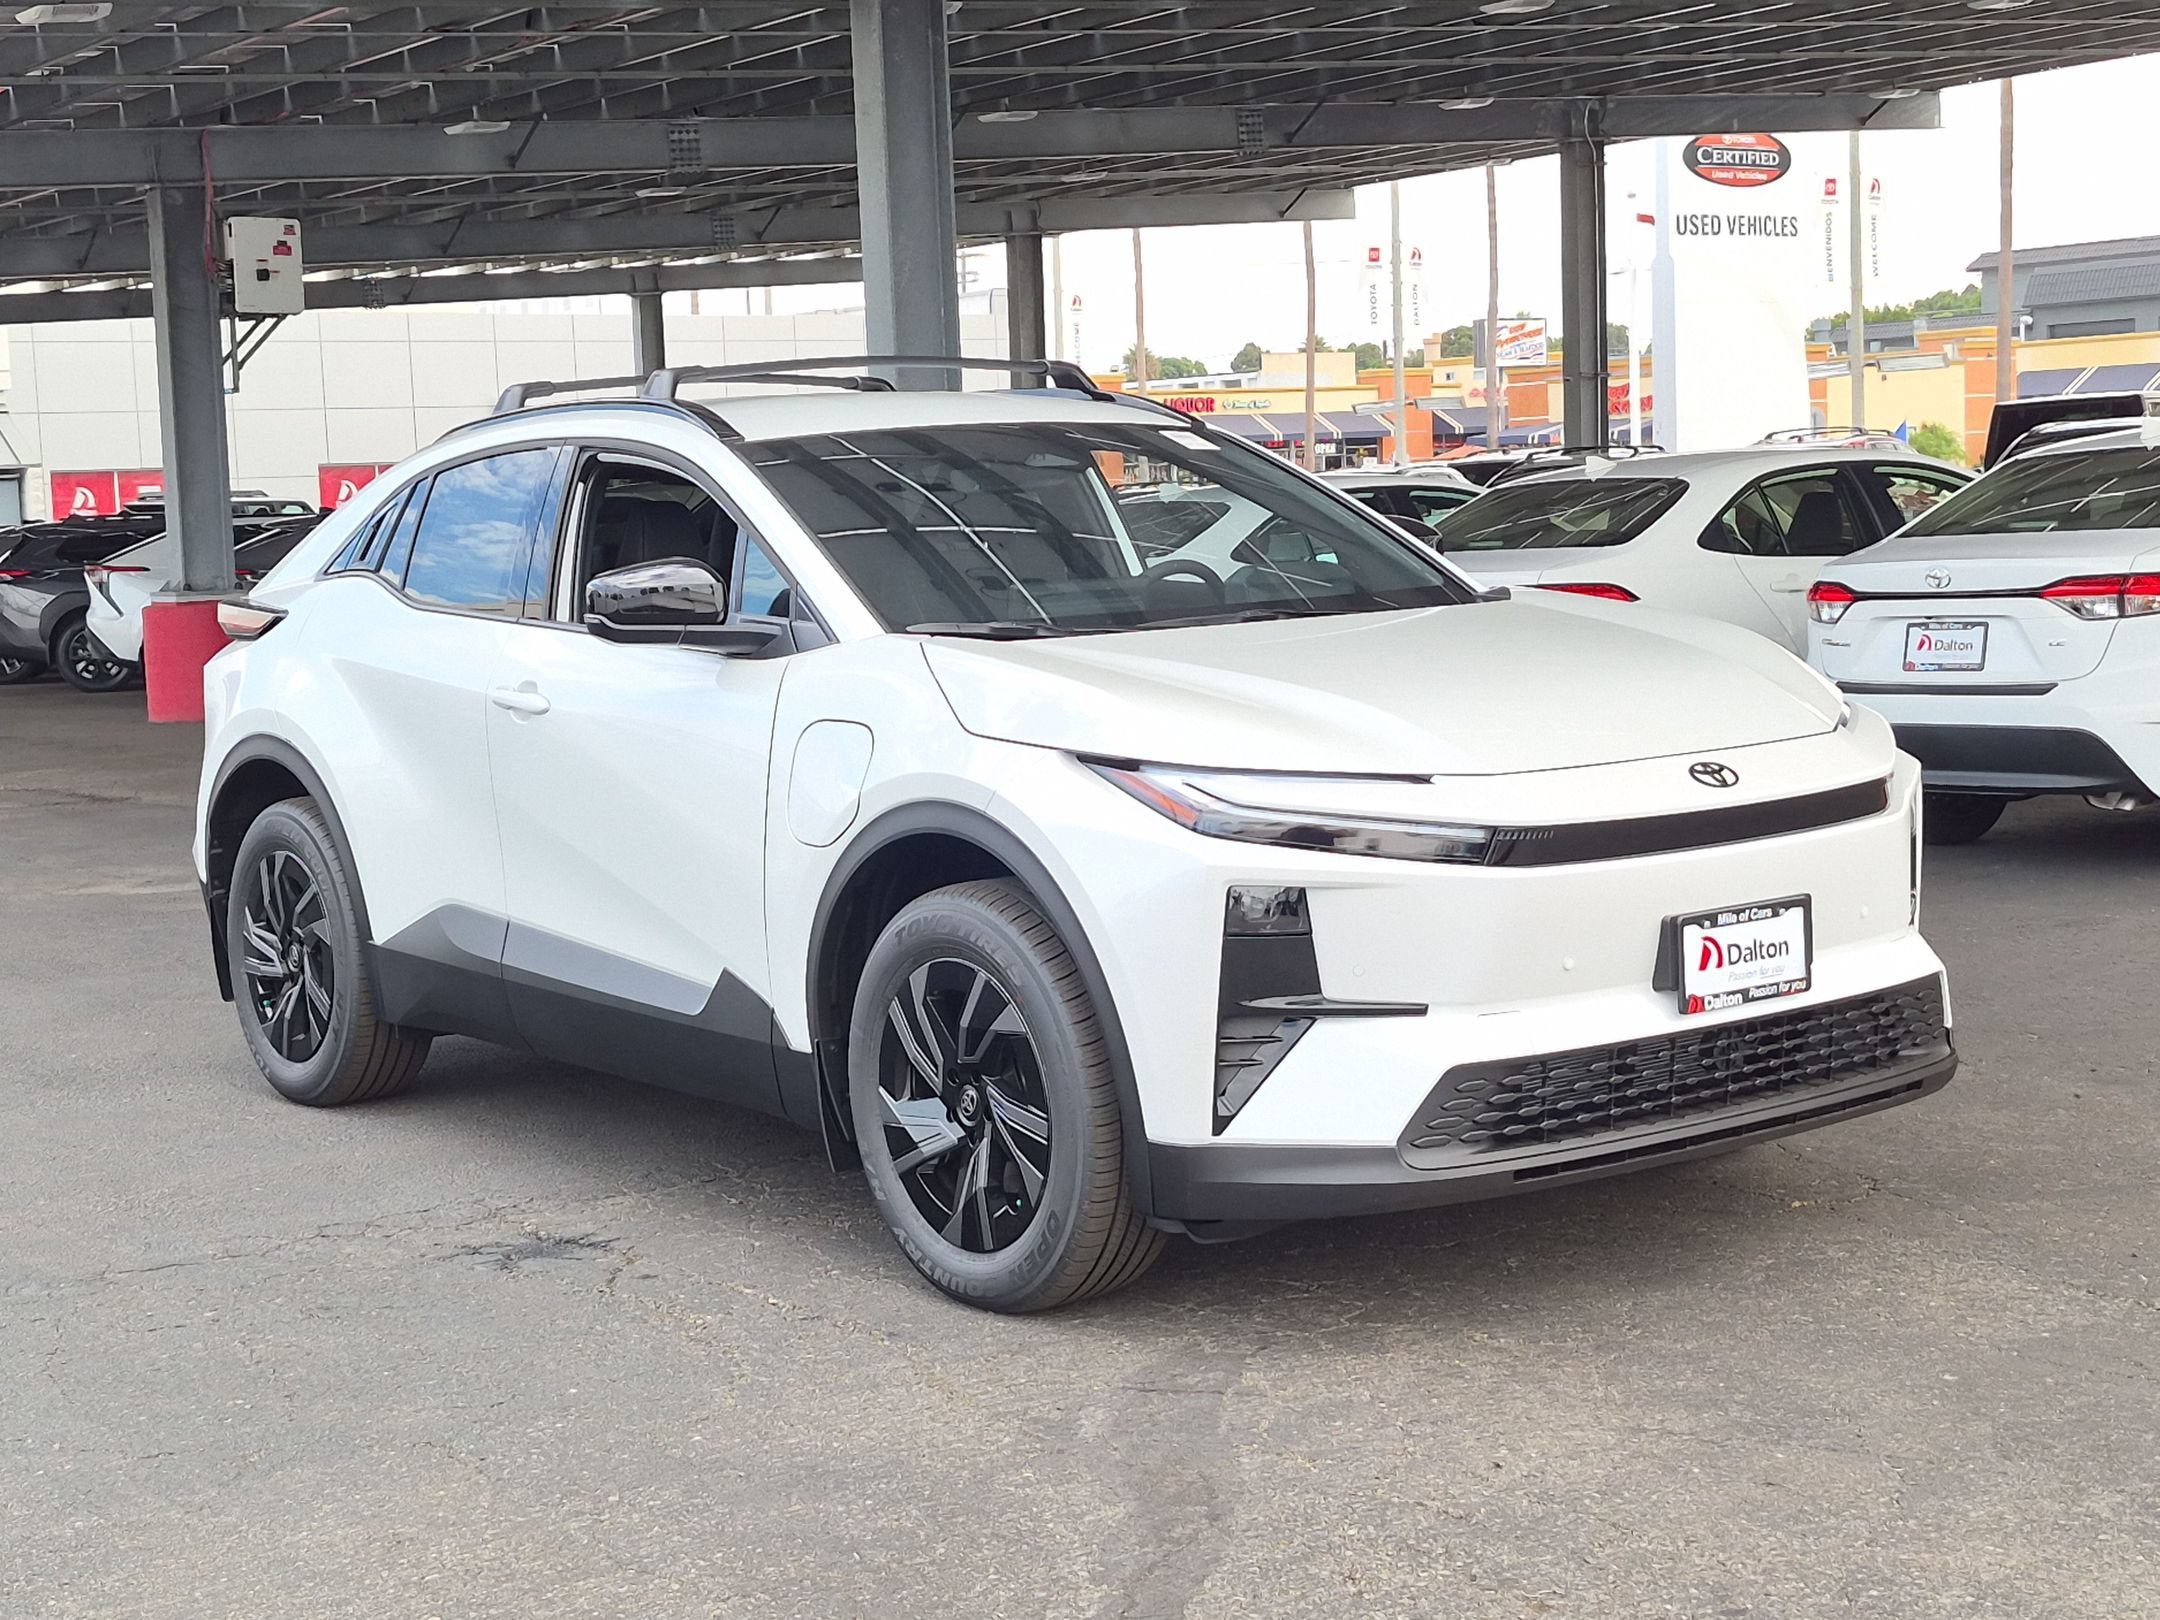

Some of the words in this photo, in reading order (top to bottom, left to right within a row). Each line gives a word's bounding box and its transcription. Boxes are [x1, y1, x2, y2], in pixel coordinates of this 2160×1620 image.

[1696, 147, 1779, 165] CERTIFIED
[1676, 214, 1721, 236] USED
[1727, 214, 1798, 237] VEHICLES
[1871, 214, 1880, 277] WELCOME
[1369, 283, 1378, 325] TOYOTA
[1314, 442, 1336, 454] OPEN
[1934, 639, 1974, 652] Dalton
[1717, 912, 1737, 926] Mile
[1738, 910, 1749, 922] of
[1750, 907, 1773, 921] Cars
[1727, 938, 1789, 966] Dalton
[1704, 993, 1743, 1011] Dalton
[1749, 985, 1777, 998] Passion
[1779, 981, 1790, 992] for
[1791, 979, 1807, 992] you
